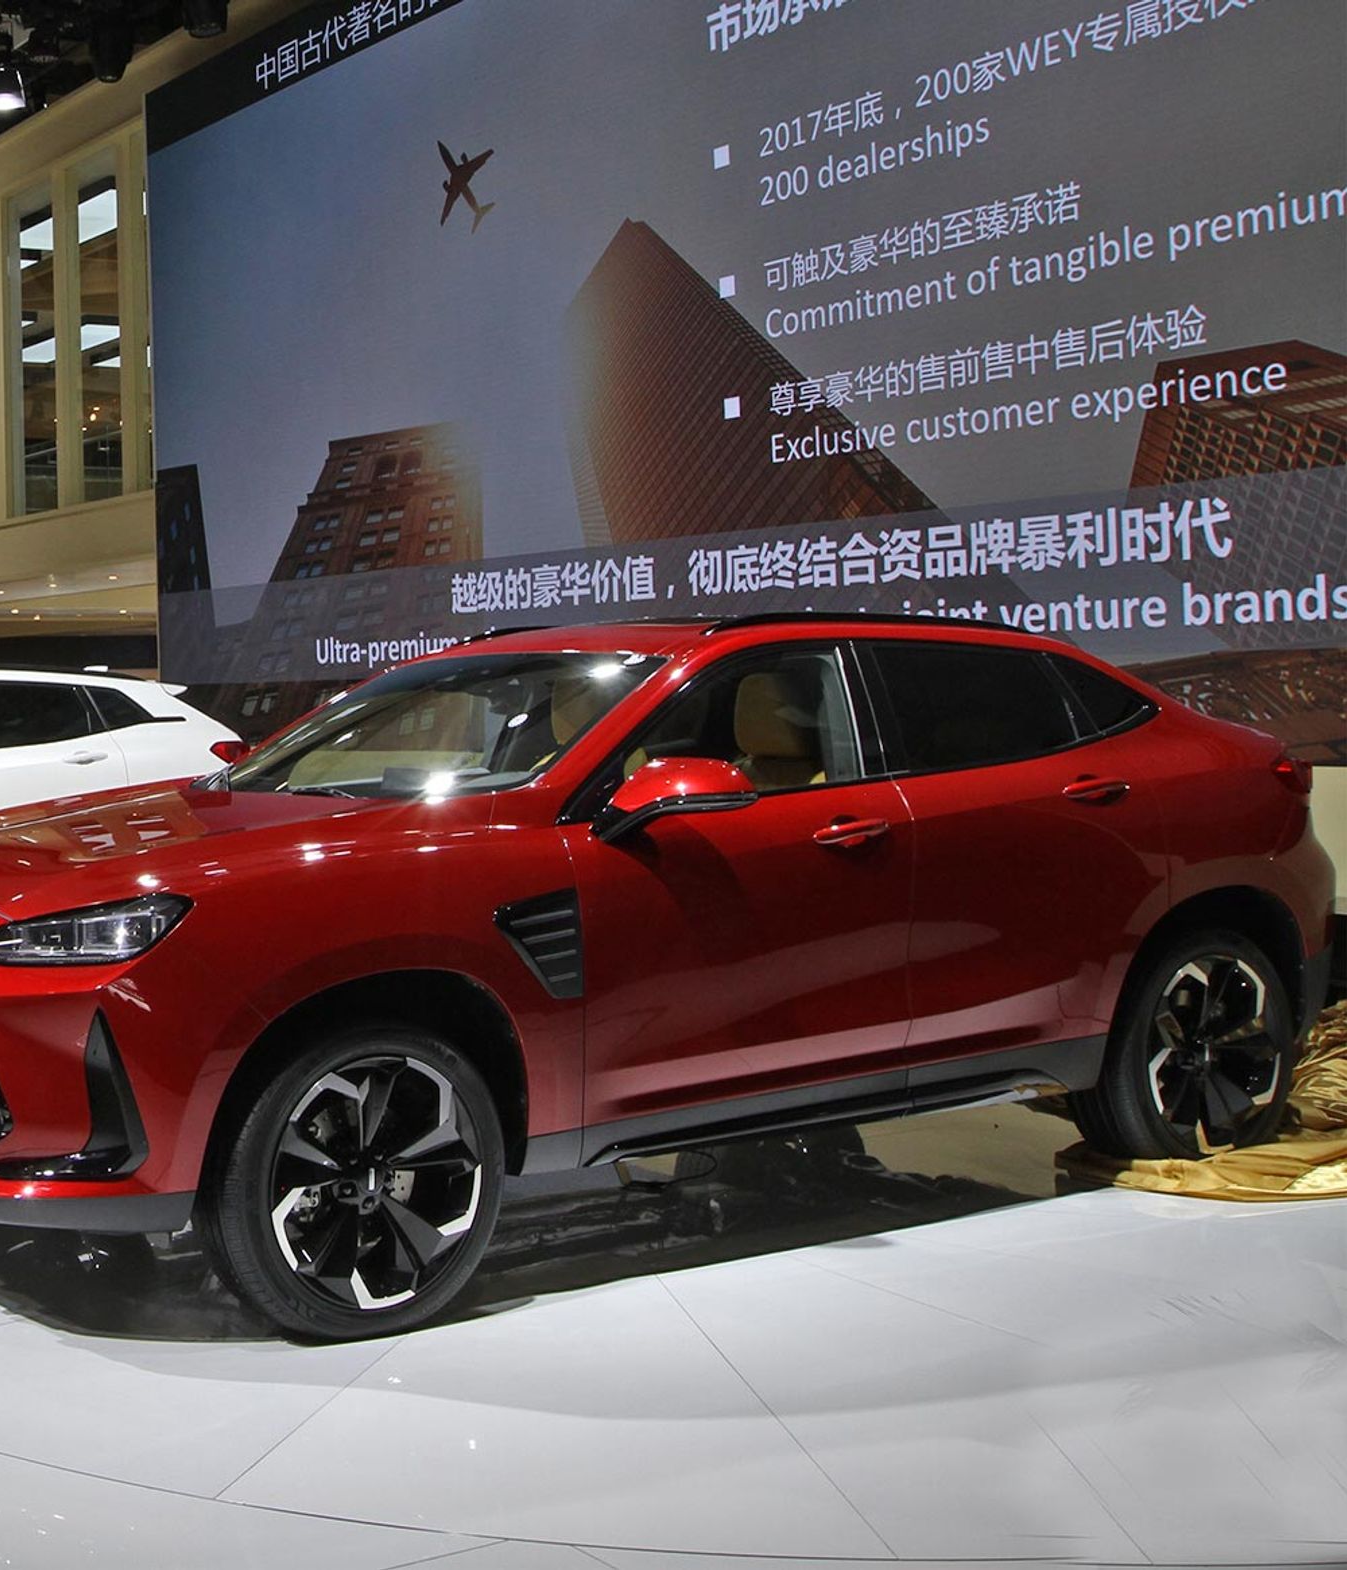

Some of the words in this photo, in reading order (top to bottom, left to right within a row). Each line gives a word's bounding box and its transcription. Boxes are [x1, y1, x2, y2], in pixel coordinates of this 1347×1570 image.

[759, 165, 810, 206] 200
[817, 116, 991, 189] dealerships
[763, 181, 1082, 293] 可触及豪华的至臻承诺
[764, 267, 957, 339] Commitment
[966, 257, 1001, 294] of
[1009, 228, 1154, 286] tangible
[1168, 186, 1347, 262] premium
[769, 304, 1208, 418] 尊享豪华的售前售中售后体验
[769, 419, 897, 464] Exclusive
[905, 396, 1060, 446] customer
[1070, 361, 1288, 423] experience
[451, 497, 1233, 615] 越级的豪华价值，彻底终结合资品牌暴利时代
[998, 593, 1168, 634] venture
[1182, 572, 1347, 627] brands
